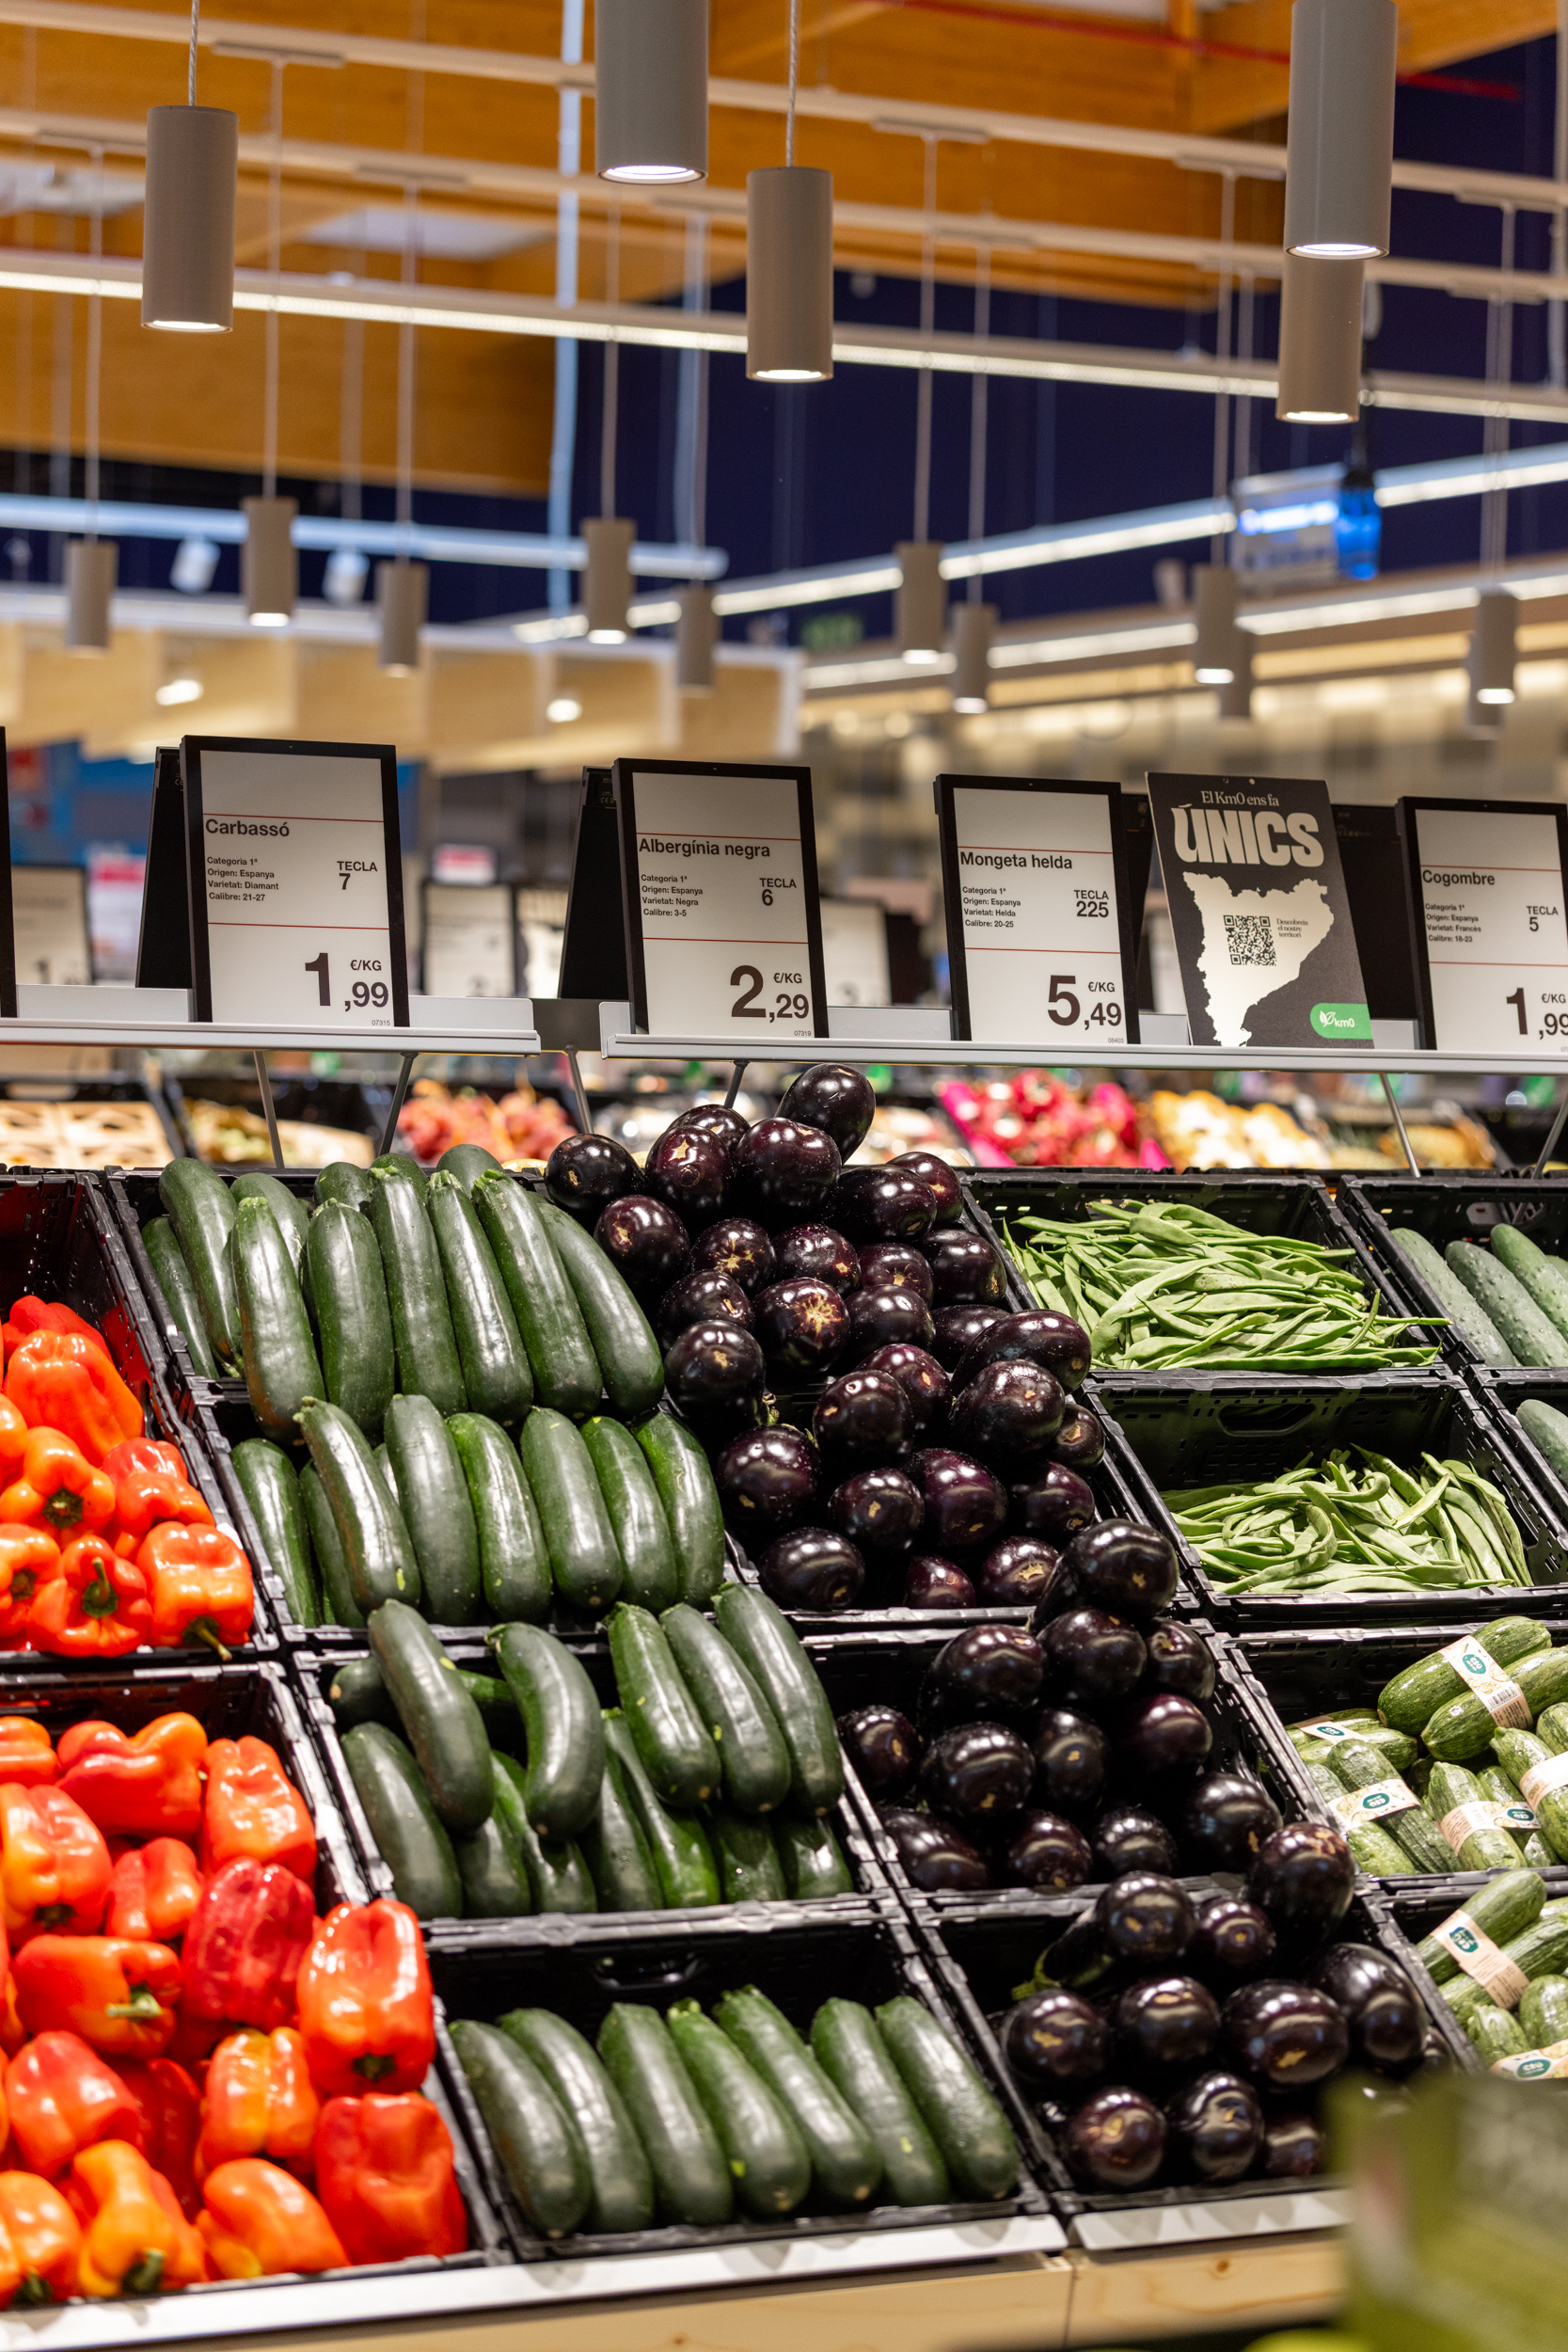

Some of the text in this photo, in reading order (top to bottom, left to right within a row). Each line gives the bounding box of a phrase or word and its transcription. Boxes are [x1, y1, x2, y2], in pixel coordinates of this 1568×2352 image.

[1201, 790, 1279, 807] El Km0 ens fa
[205, 818, 290, 837] Carbassó
[1170, 803, 1324, 867] ÚNICS
[639, 837, 770, 860] Albergínia negra
[207, 856, 247, 867] Categoria
[336, 860, 377, 872] TECLA
[959, 851, 1073, 870] Mongeta helda
[207, 868, 275, 879] Origen: Espanya
[641, 874, 678, 884] Categoria
[1422, 870, 1496, 886] Cogombre
[207, 881, 279, 890] Varietat: Diamant
[338, 873, 351, 891] 7
[759, 878, 797, 889] TECLA
[641, 885, 703, 896] Origen: Espanya
[962, 886, 997, 897] Categoria
[1073, 889, 1109, 900] TECLA
[209, 892, 265, 901] Calibre: 21-27
[642, 897, 699, 907] Varietat: Negra
[761, 888, 774, 906] 6
[963, 898, 1021, 908] Origen: Espanya
[1425, 903, 1457, 912] Categoria
[643, 908, 673, 916] Calibre:
[964, 909, 994, 917] Varietat:
[1076, 900, 1109, 918] 225
[1527, 906, 1559, 915] TECLA
[1426, 914, 1479, 923] Origen: Espanya
[1528, 916, 1539, 932] 5
[994, 920, 1014, 929] 20-25
[349, 959, 382, 972] €/KG
[773, 973, 802, 984] €/KG
[1087, 982, 1116, 993] €/KG
[1541, 993, 1566, 1004] €/KG
[371, 1019, 390, 1027] 07315
[1334, 1018, 1355, 1027] km0
